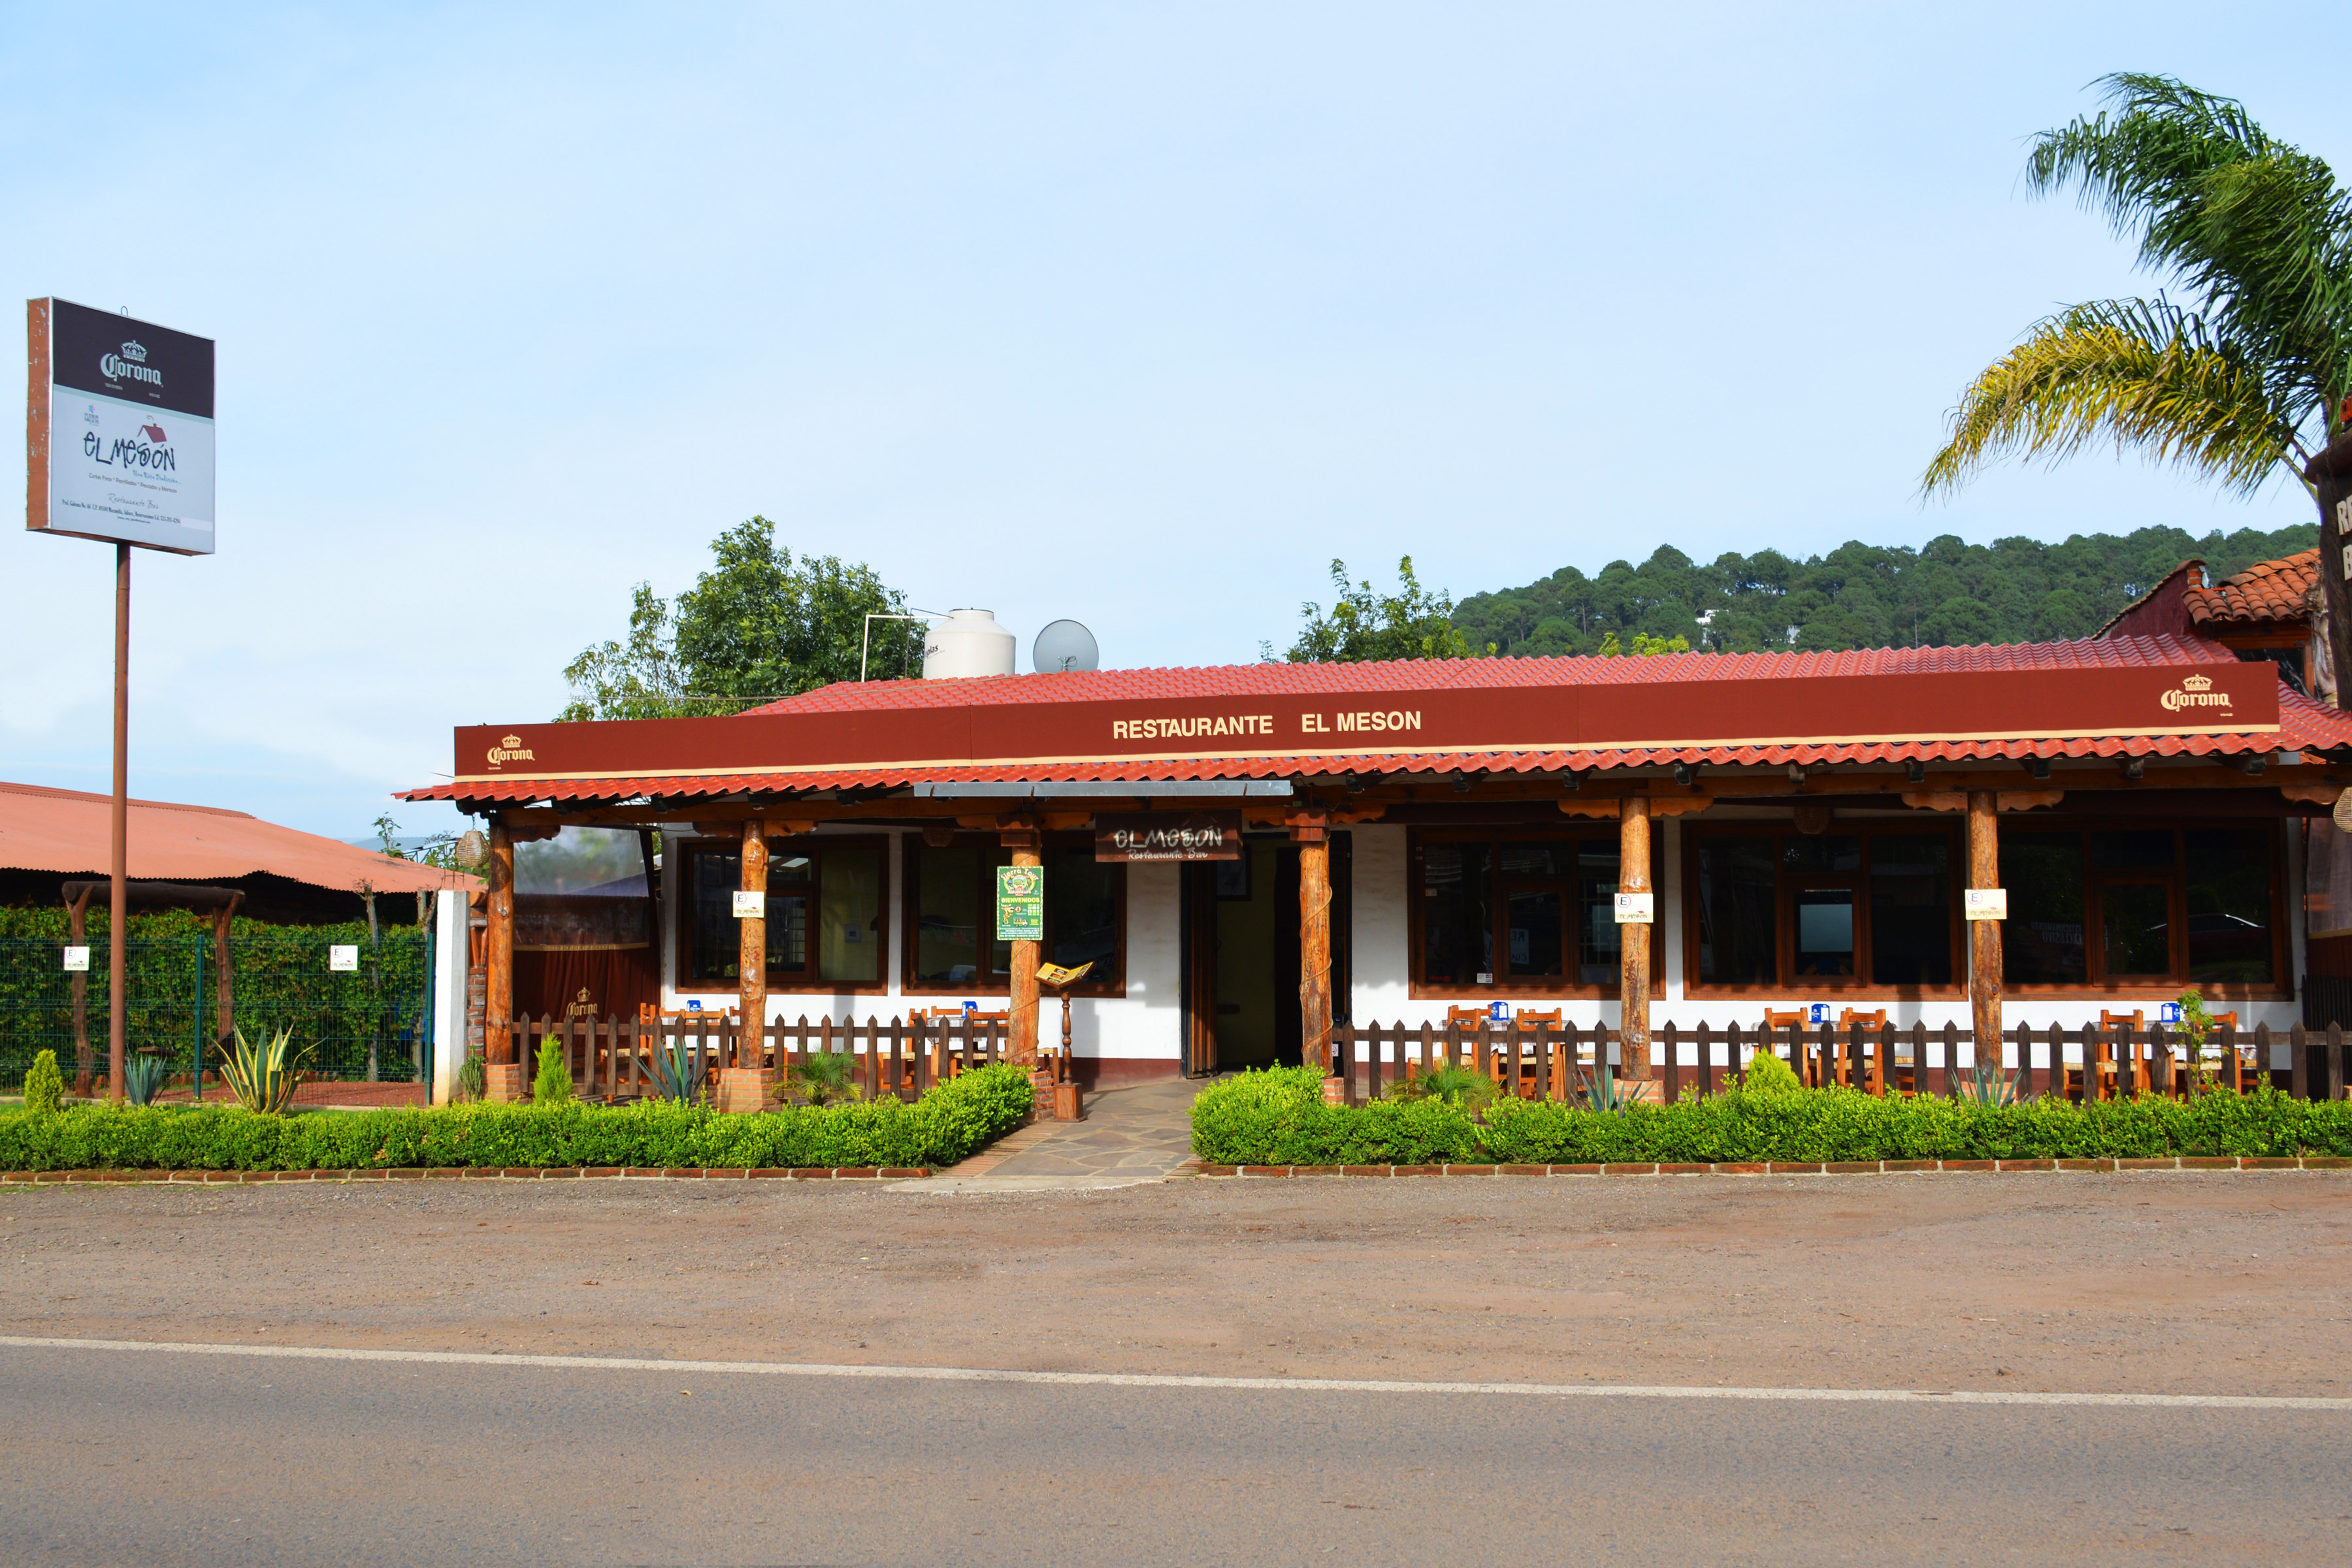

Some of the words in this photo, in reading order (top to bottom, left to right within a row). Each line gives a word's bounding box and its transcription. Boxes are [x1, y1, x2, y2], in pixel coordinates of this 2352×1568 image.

[100, 353, 163, 386] Corona
[107, 493, 145, 507] Restaurante
[2161, 689, 2230, 712] Corona
[1113, 715, 1273, 740] RESTAURANTE
[1301, 713, 1330, 733] EL
[1337, 710, 1422, 732] MESON
[487, 747, 534, 766] Corona
[1126, 849, 1183, 860] Restaurante
[1186, 847, 1208, 859] Bar
[1024, 868, 1039, 881] Tour
[738, 894, 743, 902] E
[1620, 896, 1627, 906] E
[1971, 892, 1979, 902] E
[68, 949, 73, 957] E
